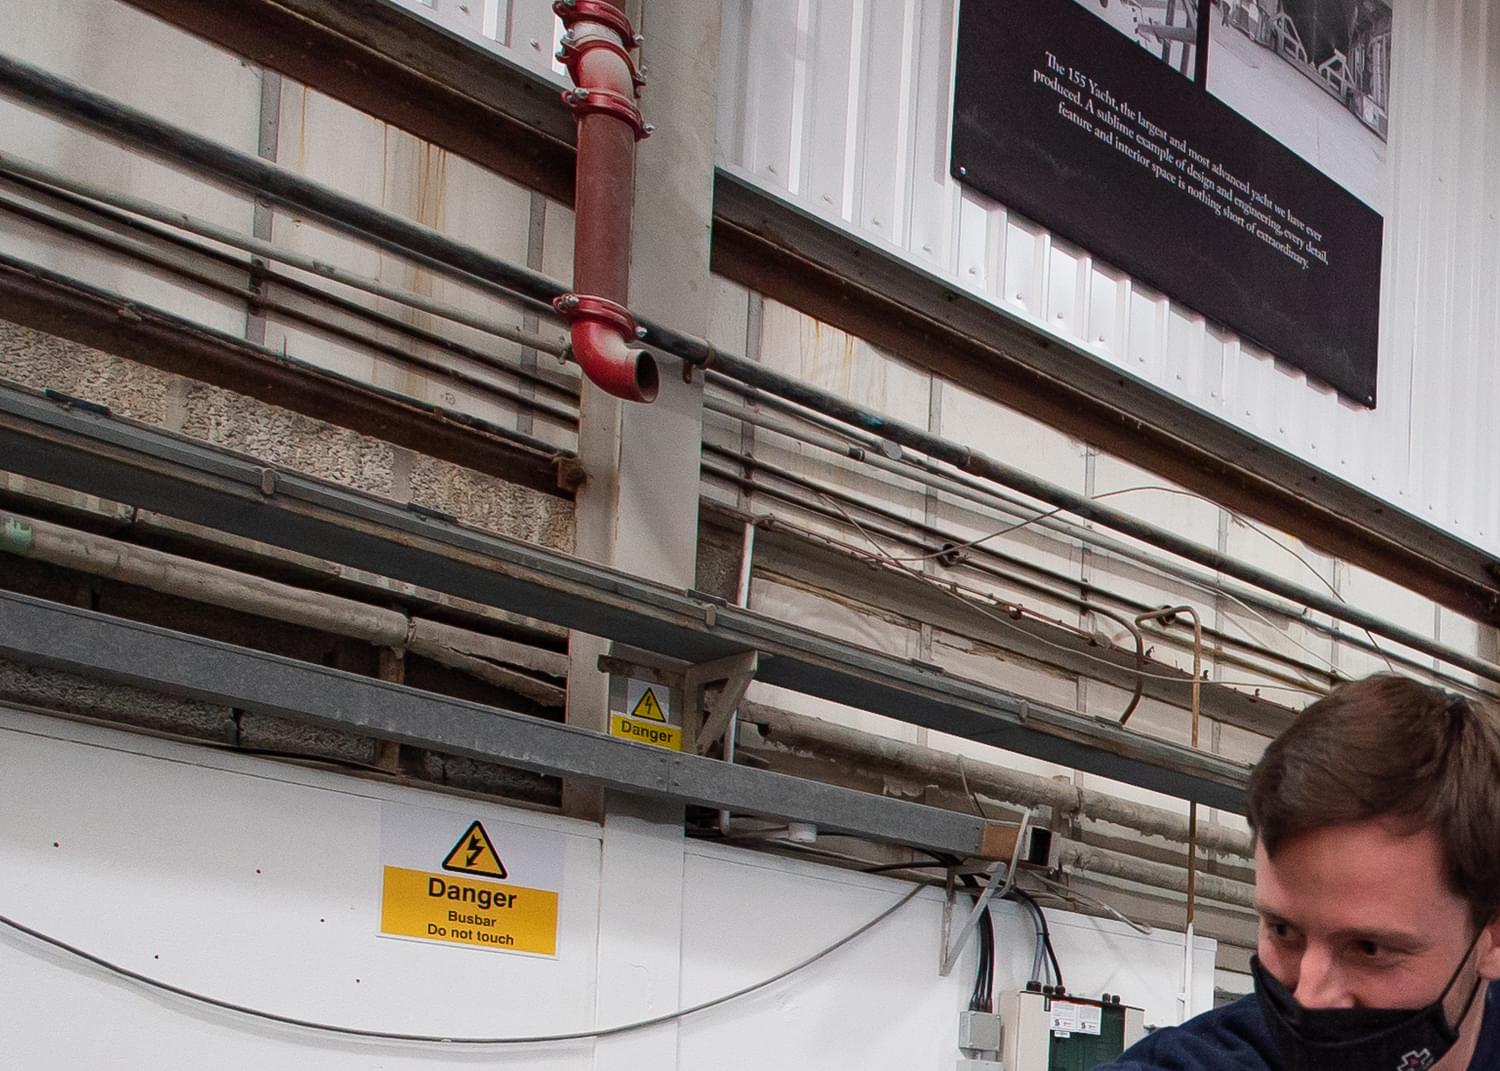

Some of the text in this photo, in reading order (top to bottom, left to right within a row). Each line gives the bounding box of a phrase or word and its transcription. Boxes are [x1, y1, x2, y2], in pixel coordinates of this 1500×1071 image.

[1045, 51, 1322, 242] The 155 Yacht, the largest and most advanced yacht we have ever
[1033, 69, 1329, 265] produced. A sublime example of design and engineering, every detail,
[1058, 101, 1309, 270] feature and interior space is nothing short of extraordinary.
[621, 720, 673, 743] Danger
[428, 877, 517, 910] Danger
[427, 923, 514, 945] Do not touch
[448, 910, 497, 927] Busbar
